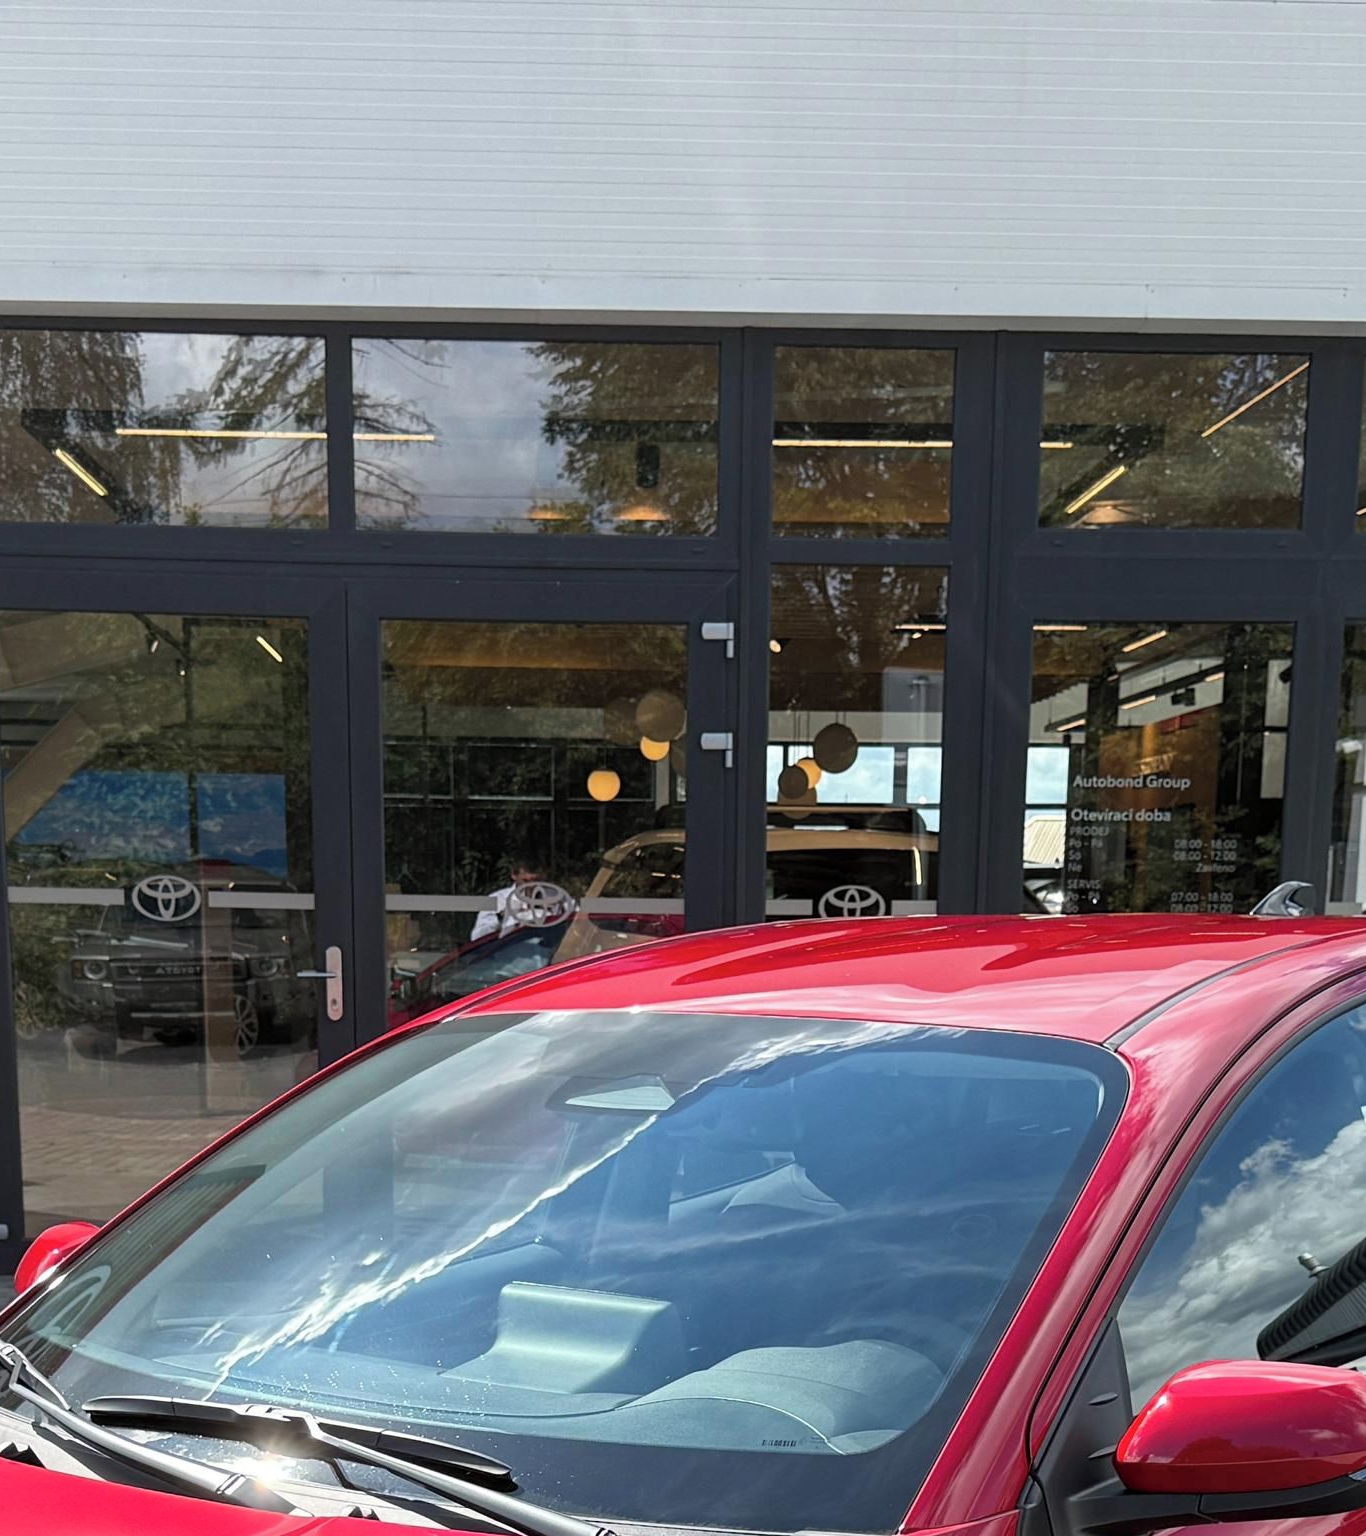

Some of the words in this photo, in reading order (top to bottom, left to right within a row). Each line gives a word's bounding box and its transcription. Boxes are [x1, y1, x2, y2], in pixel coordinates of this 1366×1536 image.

[1072, 775, 1143, 789] Autobond
[1146, 775, 1191, 791] Group
[1135, 807, 1172, 822] doba
[1069, 826, 1109, 837] PRODEJ
